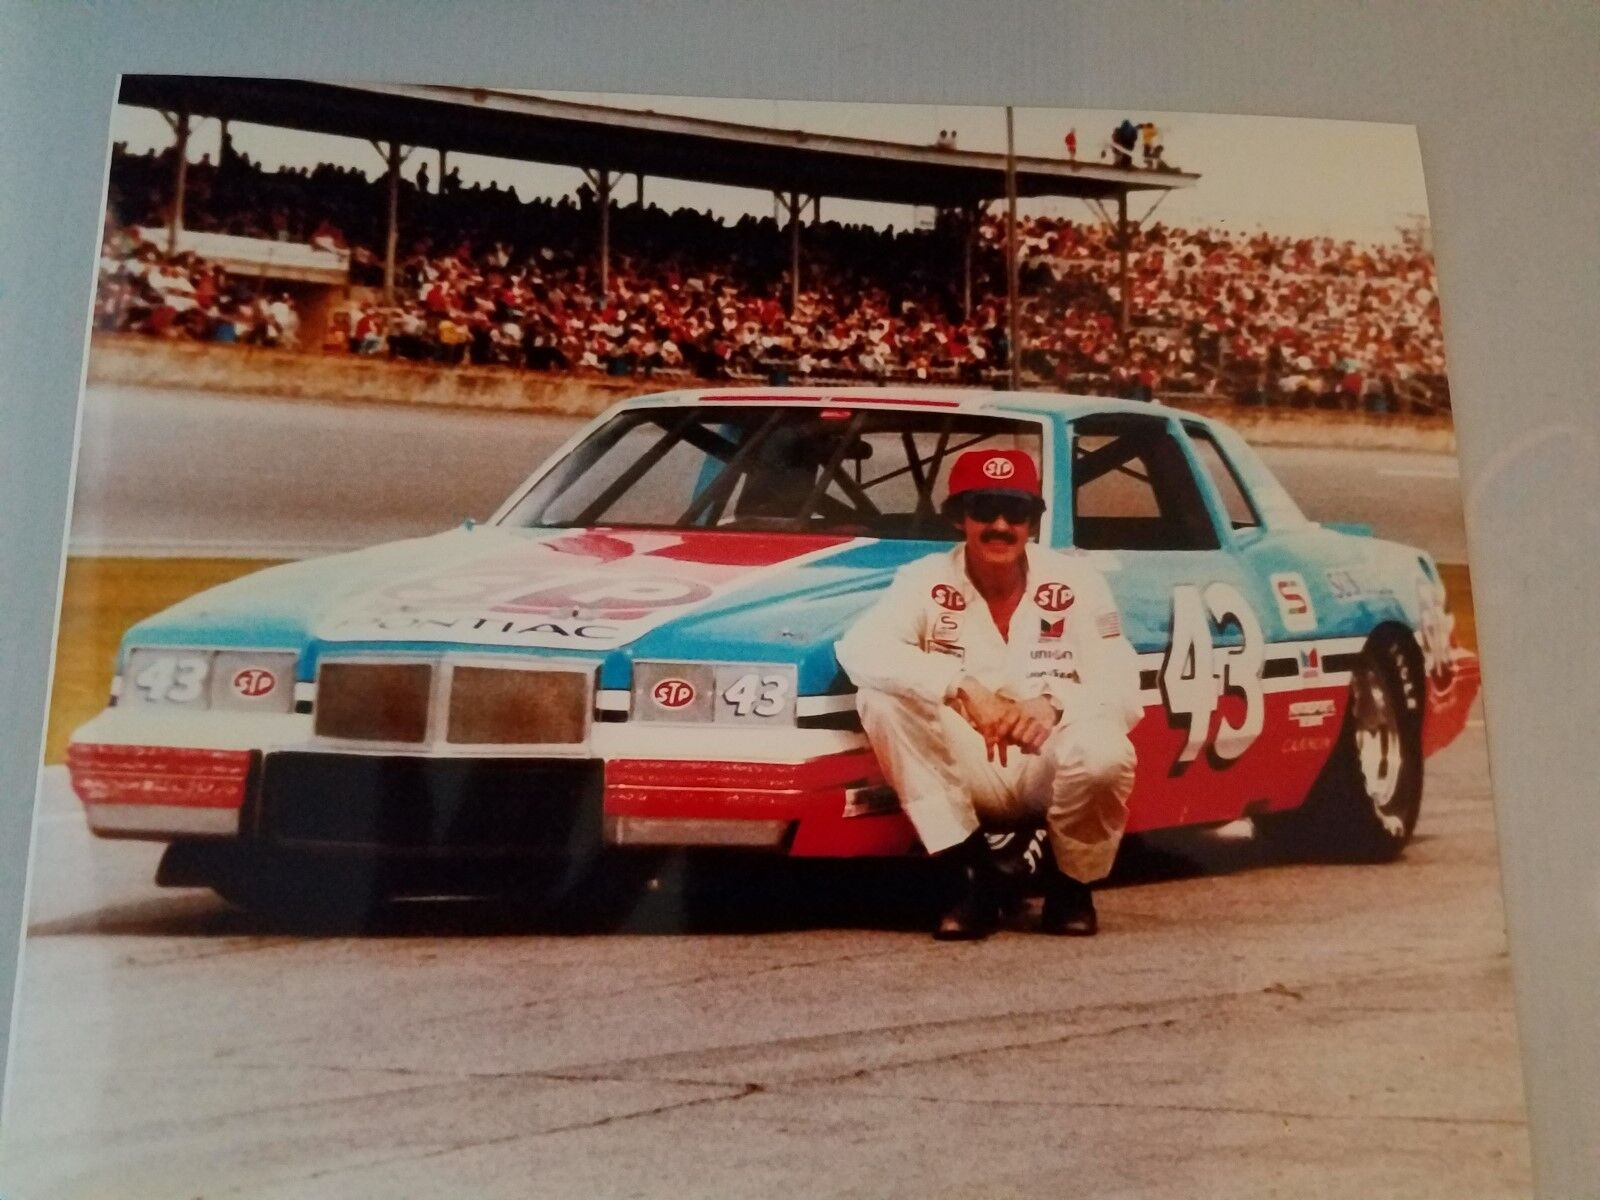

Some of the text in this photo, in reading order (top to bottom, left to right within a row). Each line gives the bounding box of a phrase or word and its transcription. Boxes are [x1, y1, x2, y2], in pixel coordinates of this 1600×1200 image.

[985, 458, 1013, 478] STP
[1036, 583, 1075, 611] STP
[136, 656, 207, 703] 43
[235, 669, 275, 695] STP
[656, 680, 695, 707] STP
[1160, 583, 1265, 778] 43
[722, 674, 789, 717] 43
